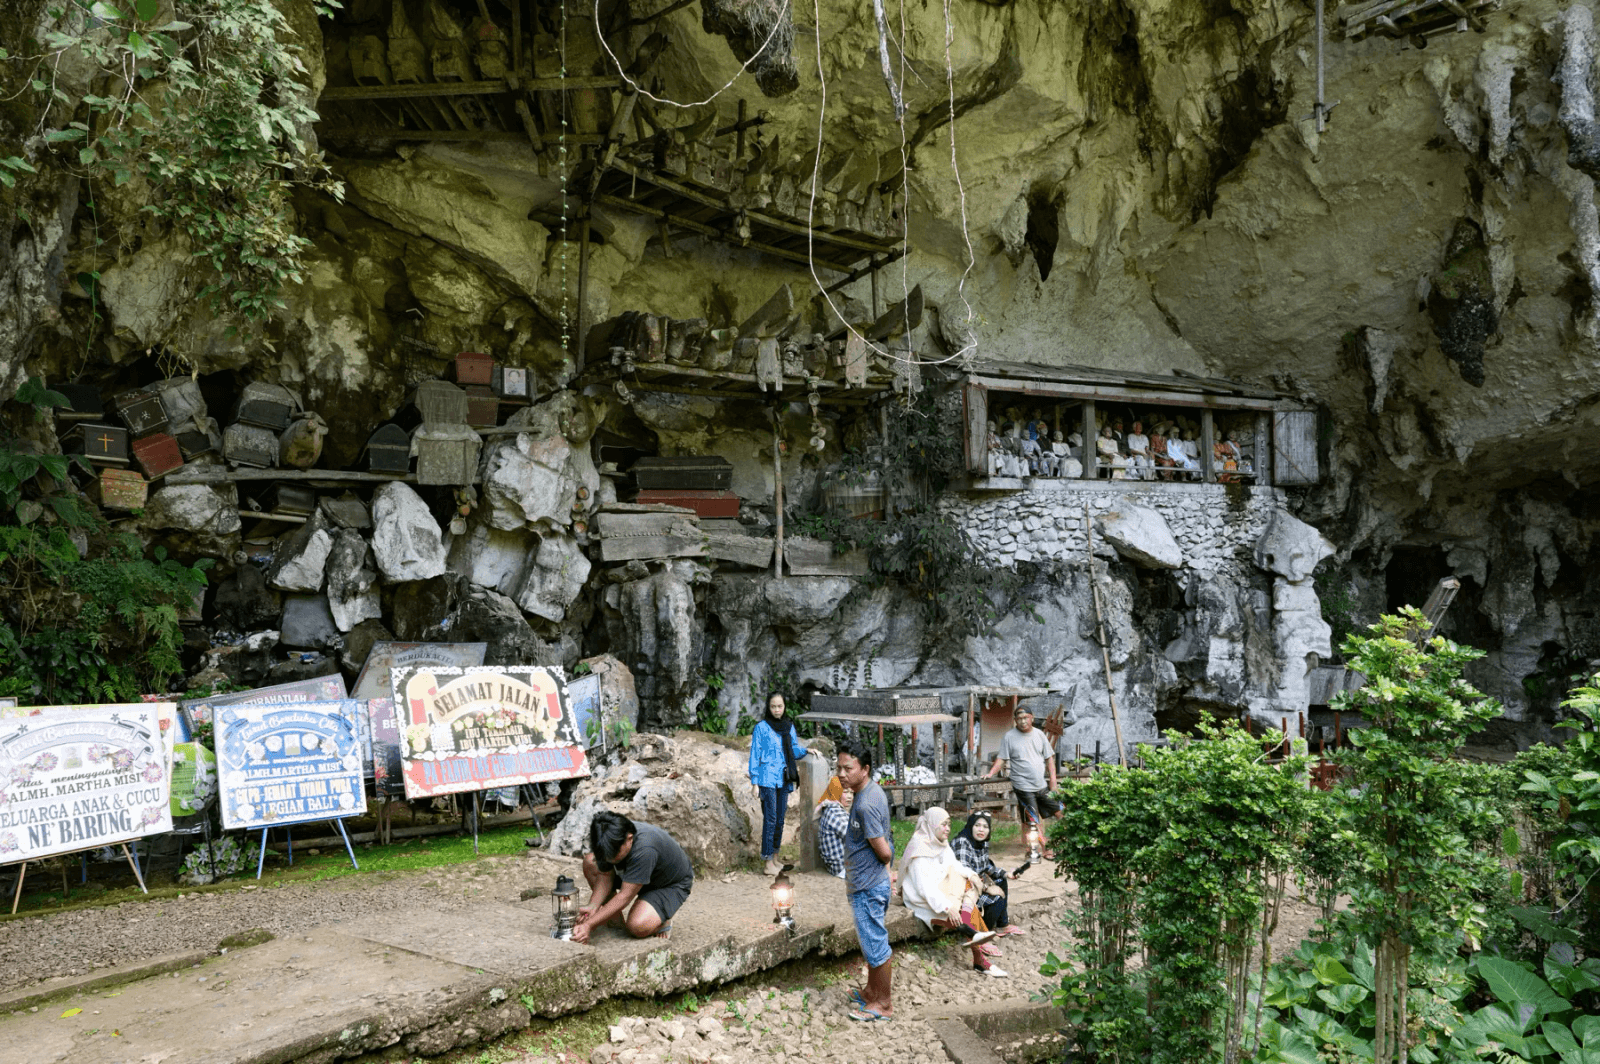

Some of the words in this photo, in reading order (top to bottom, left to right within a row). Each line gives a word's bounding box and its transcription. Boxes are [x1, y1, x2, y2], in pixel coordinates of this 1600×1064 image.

[433, 682, 493, 717] SELAMAT
[499, 683, 541, 713] JALAN
[10, 787, 54, 804] ALMH.
[56, 777, 112, 796] MARTHA
[17, 779, 44, 789] Atas
[0, 803, 69, 828] ELUARGA
[72, 795, 111, 816] ANAK
[113, 793, 125, 810] &
[126, 787, 161, 806] CUCU
[27, 822, 56, 850] NE'
[59, 808, 132, 845] BARUNG
